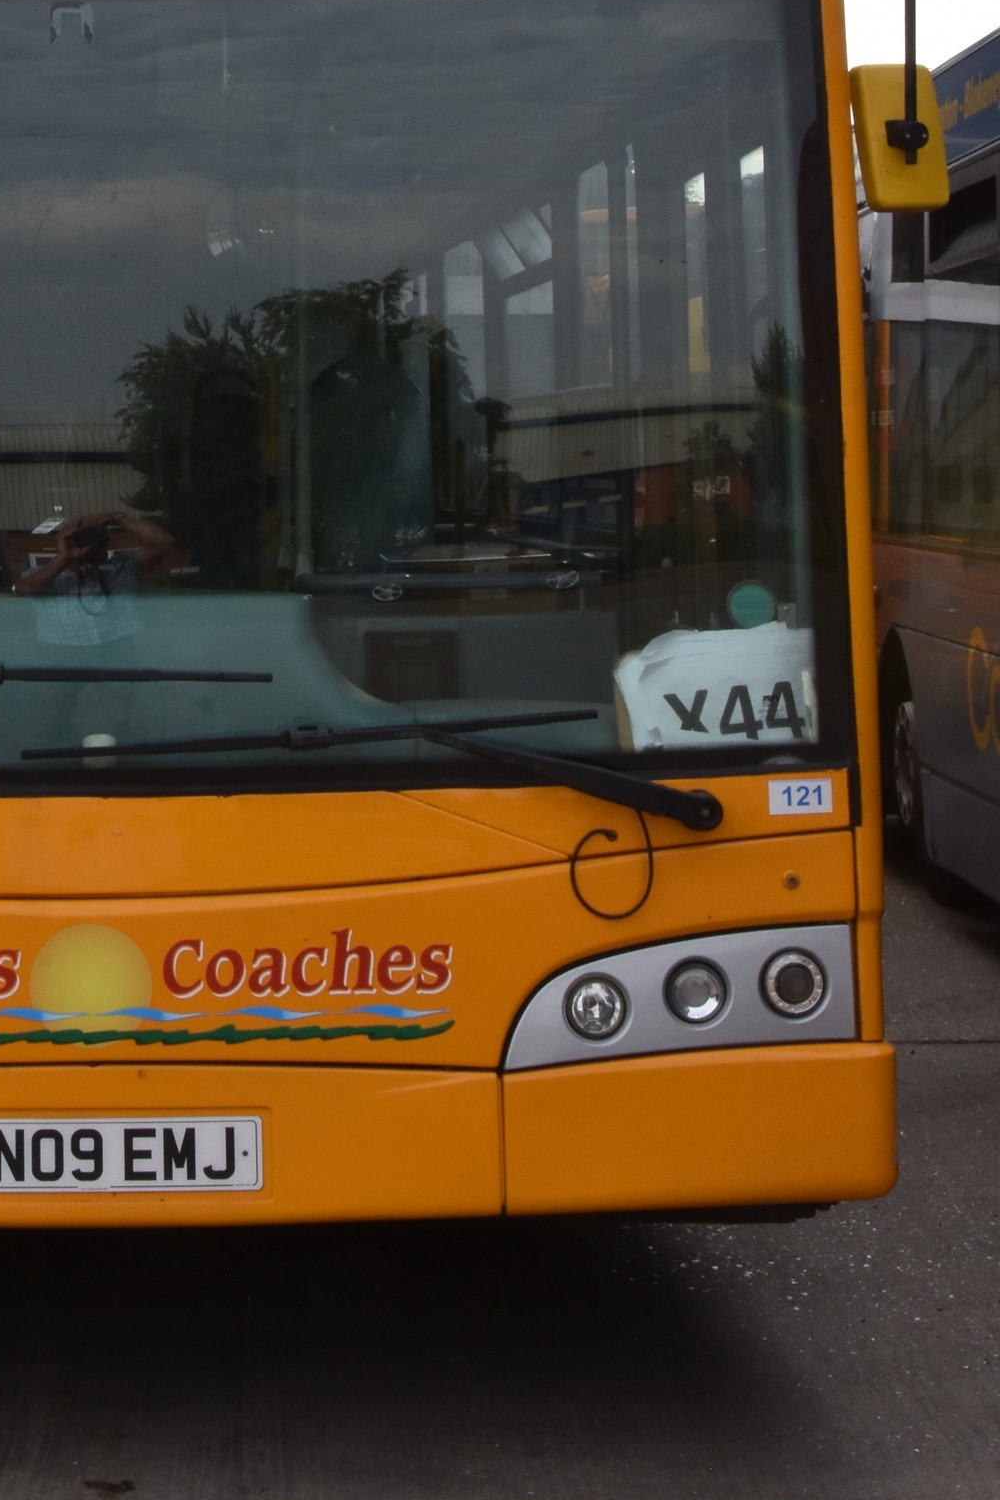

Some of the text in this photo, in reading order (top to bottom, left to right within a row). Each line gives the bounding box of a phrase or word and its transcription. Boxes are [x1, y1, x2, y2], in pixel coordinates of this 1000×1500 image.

[781, 784, 823, 807] 121
[162, 927, 454, 1000] Coaches
[123, 1125, 238, 1181] EMJ
